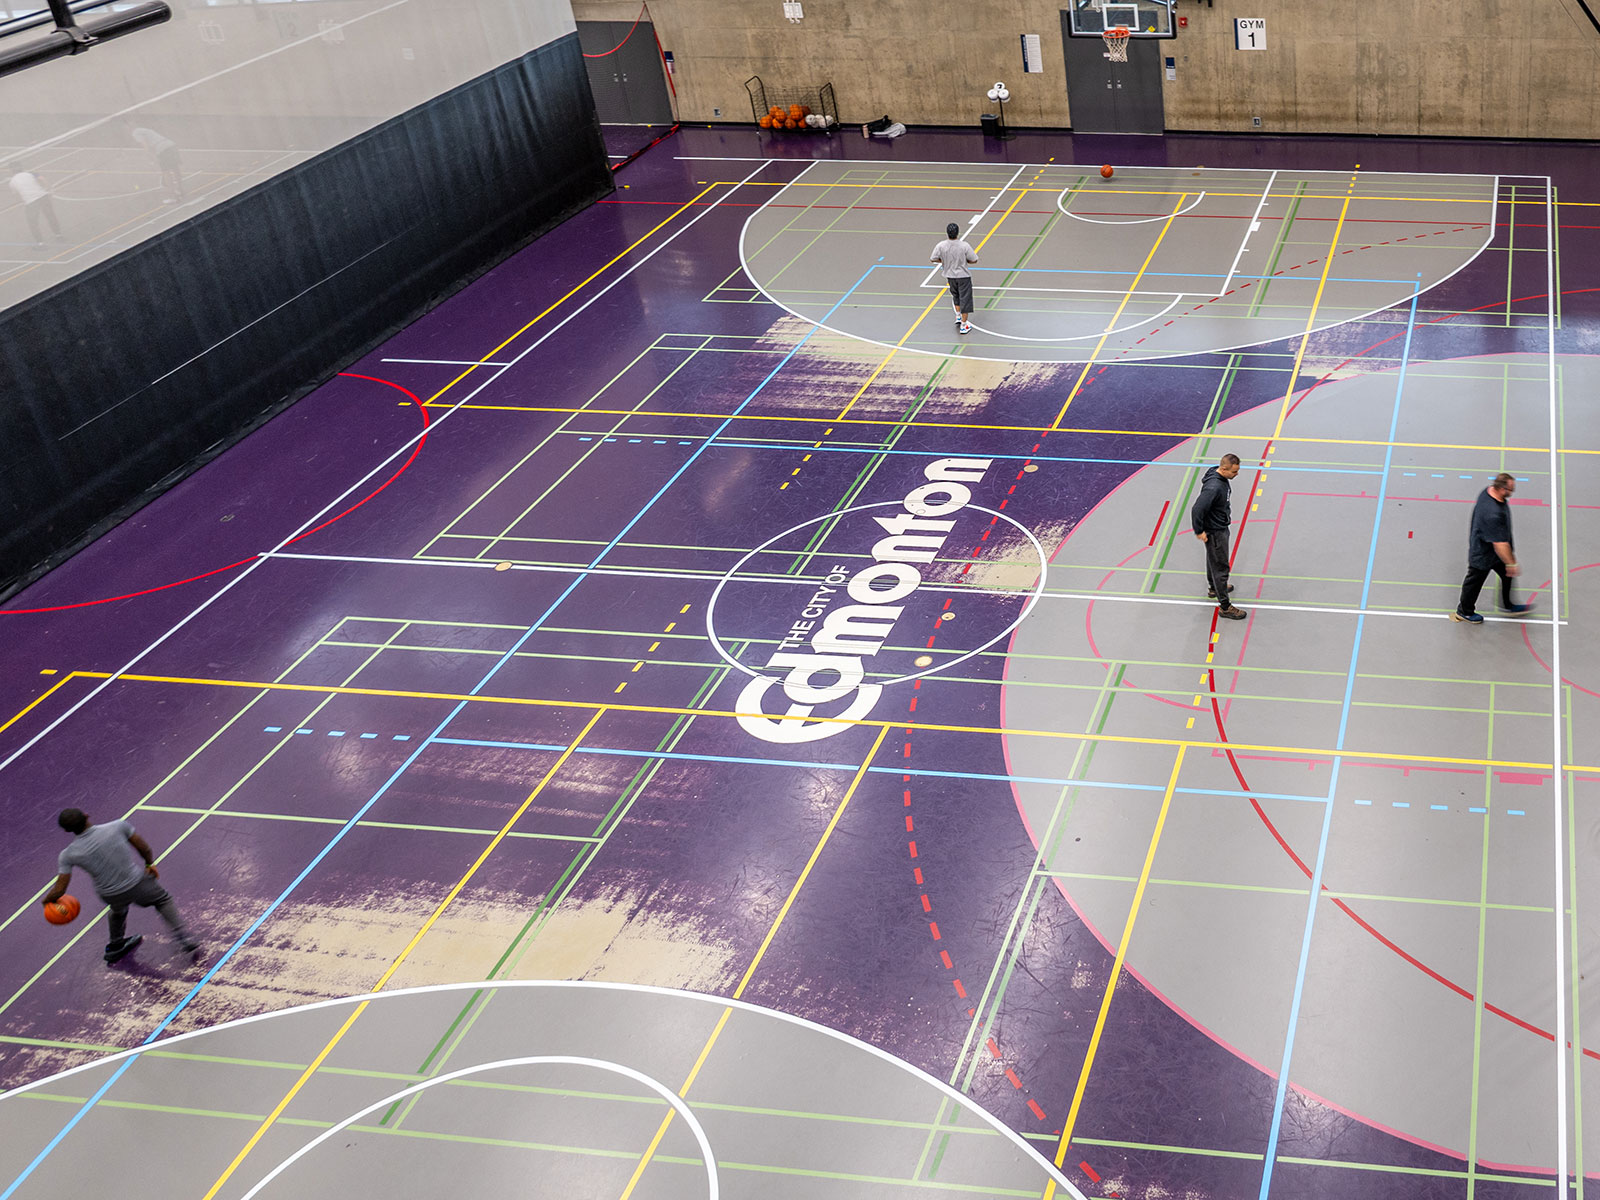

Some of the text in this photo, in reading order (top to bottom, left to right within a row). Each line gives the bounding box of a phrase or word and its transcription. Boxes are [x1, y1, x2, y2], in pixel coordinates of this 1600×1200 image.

[1240, 20, 1263, 29] GYM
[1248, 32, 1255, 47] 1
[777, 565, 850, 650] THE CITY OF
